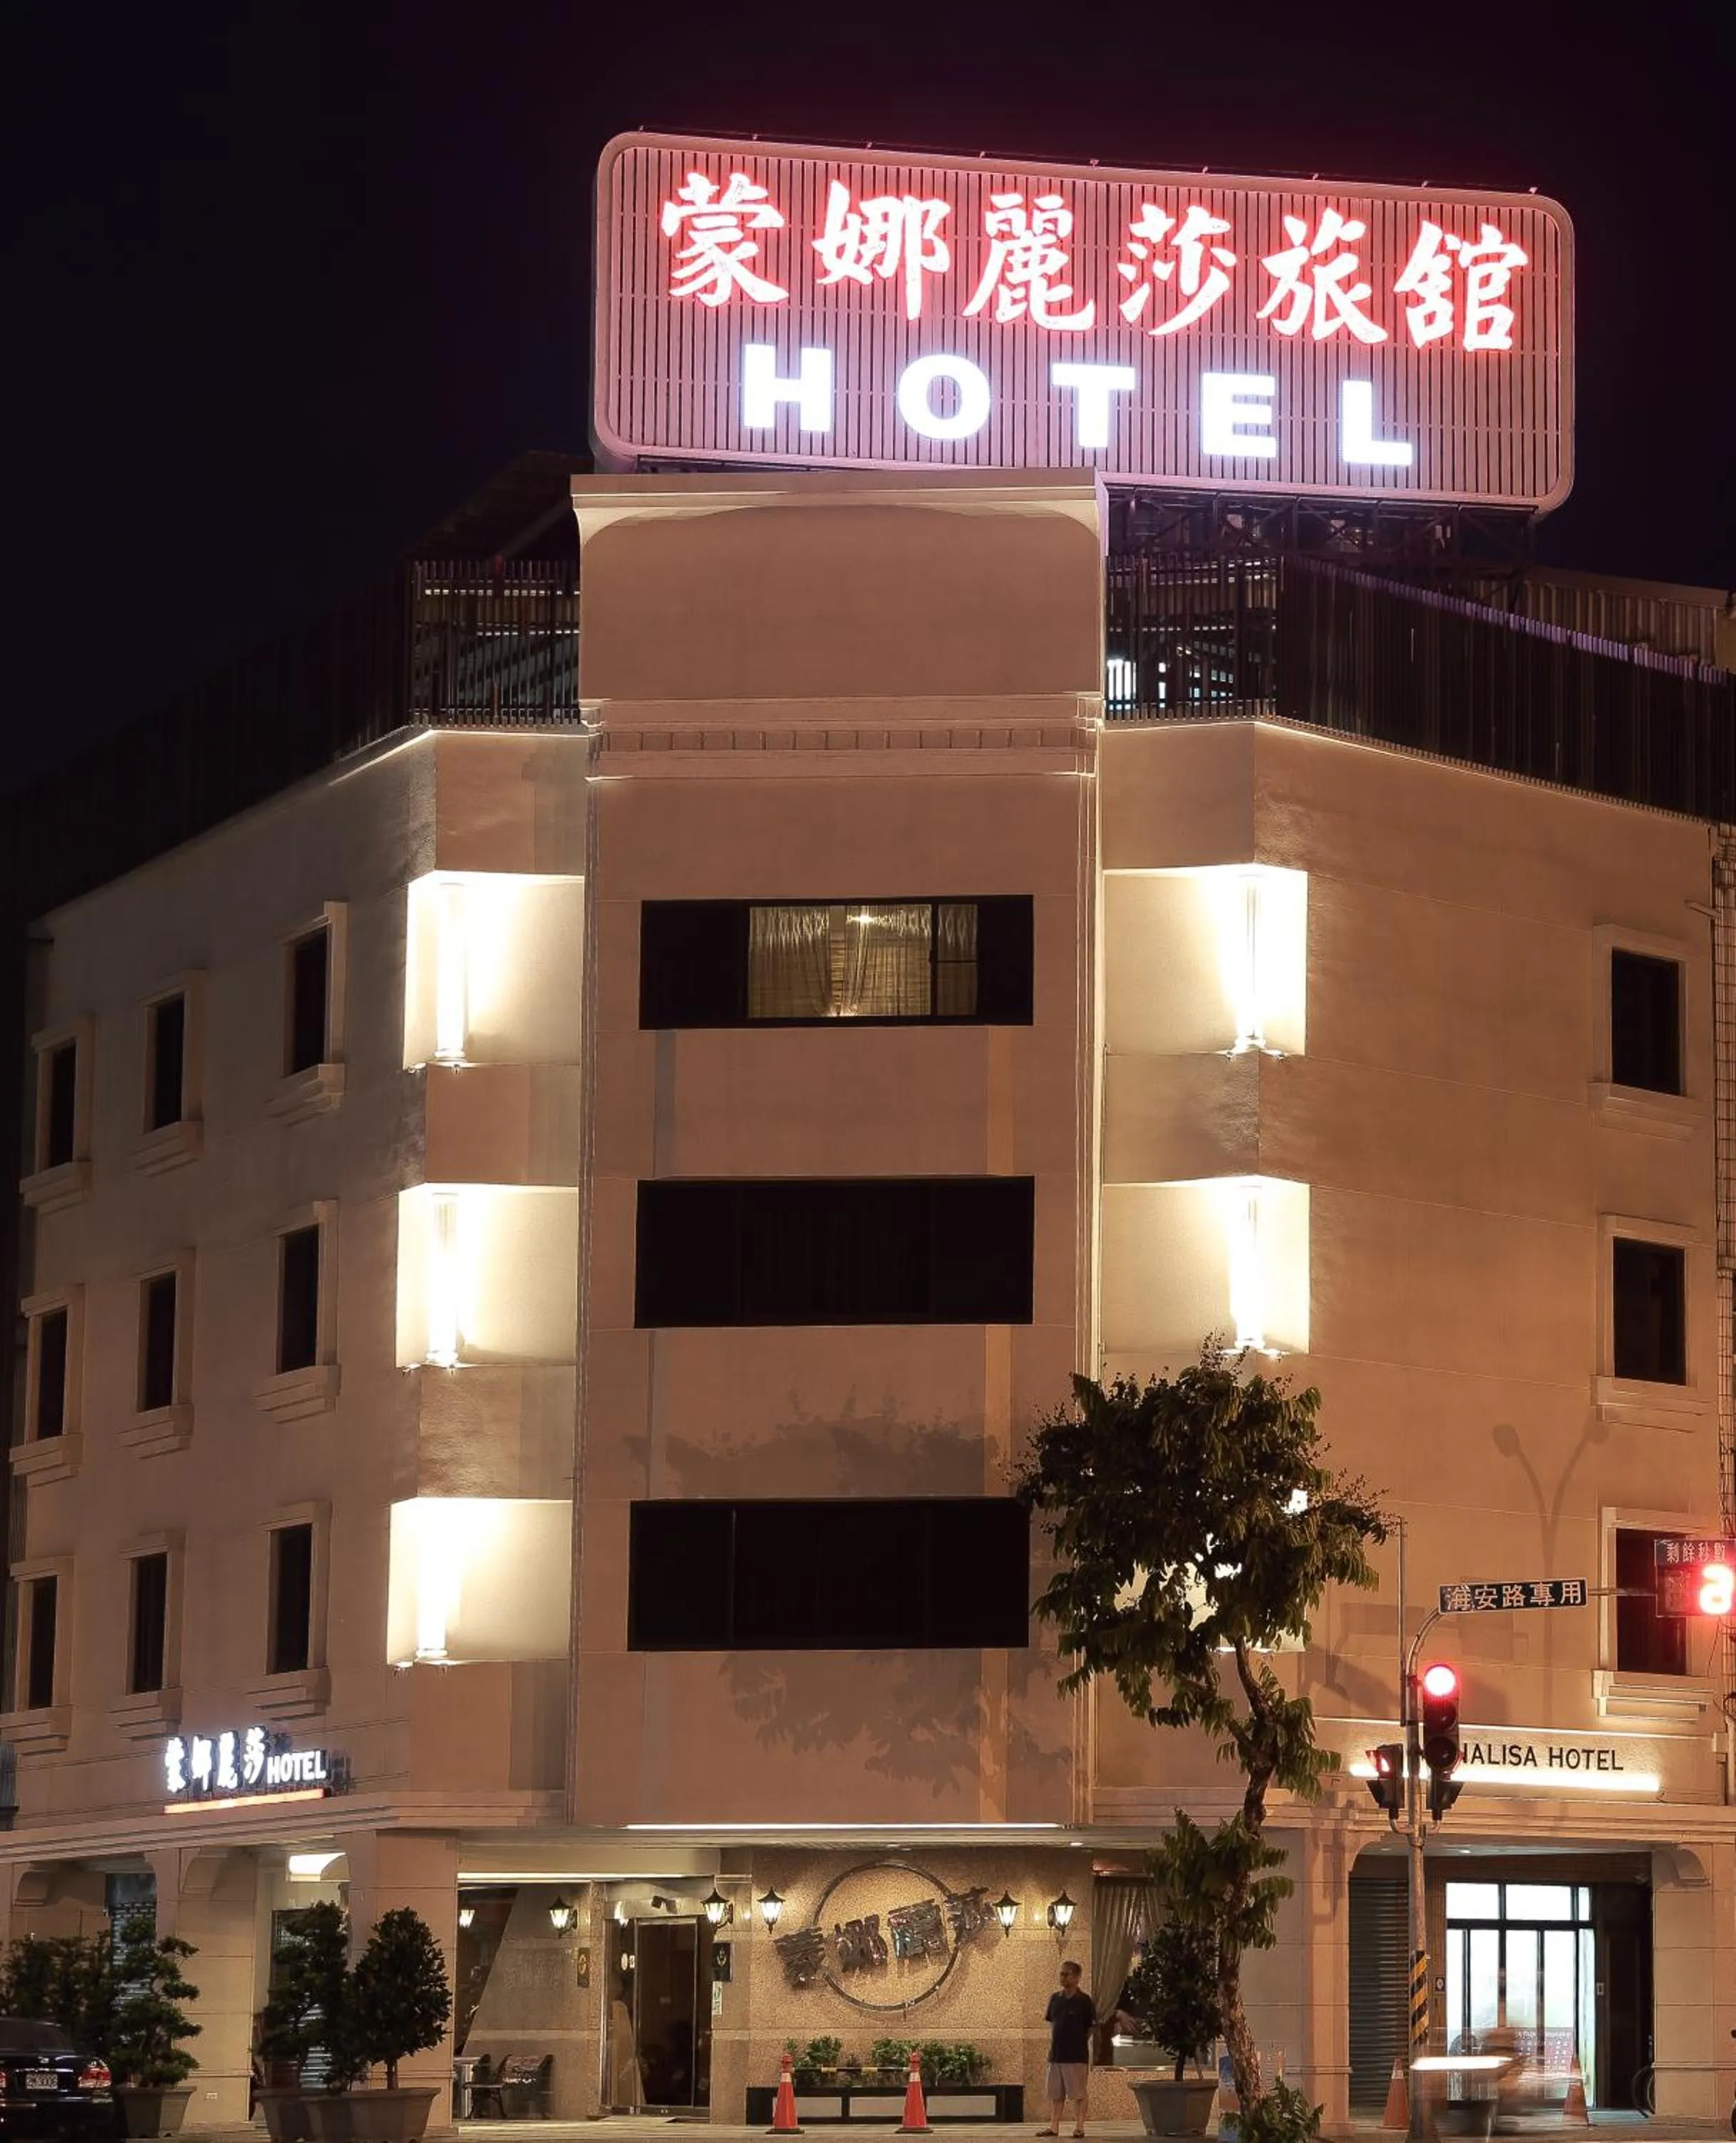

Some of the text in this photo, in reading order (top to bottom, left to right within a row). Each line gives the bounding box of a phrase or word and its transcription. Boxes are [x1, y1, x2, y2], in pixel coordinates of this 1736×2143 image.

[739, 342, 1415, 468] HOTEL
[266, 1750, 327, 1784] HOTEL
[1549, 1746, 1625, 1772] HOTEL
